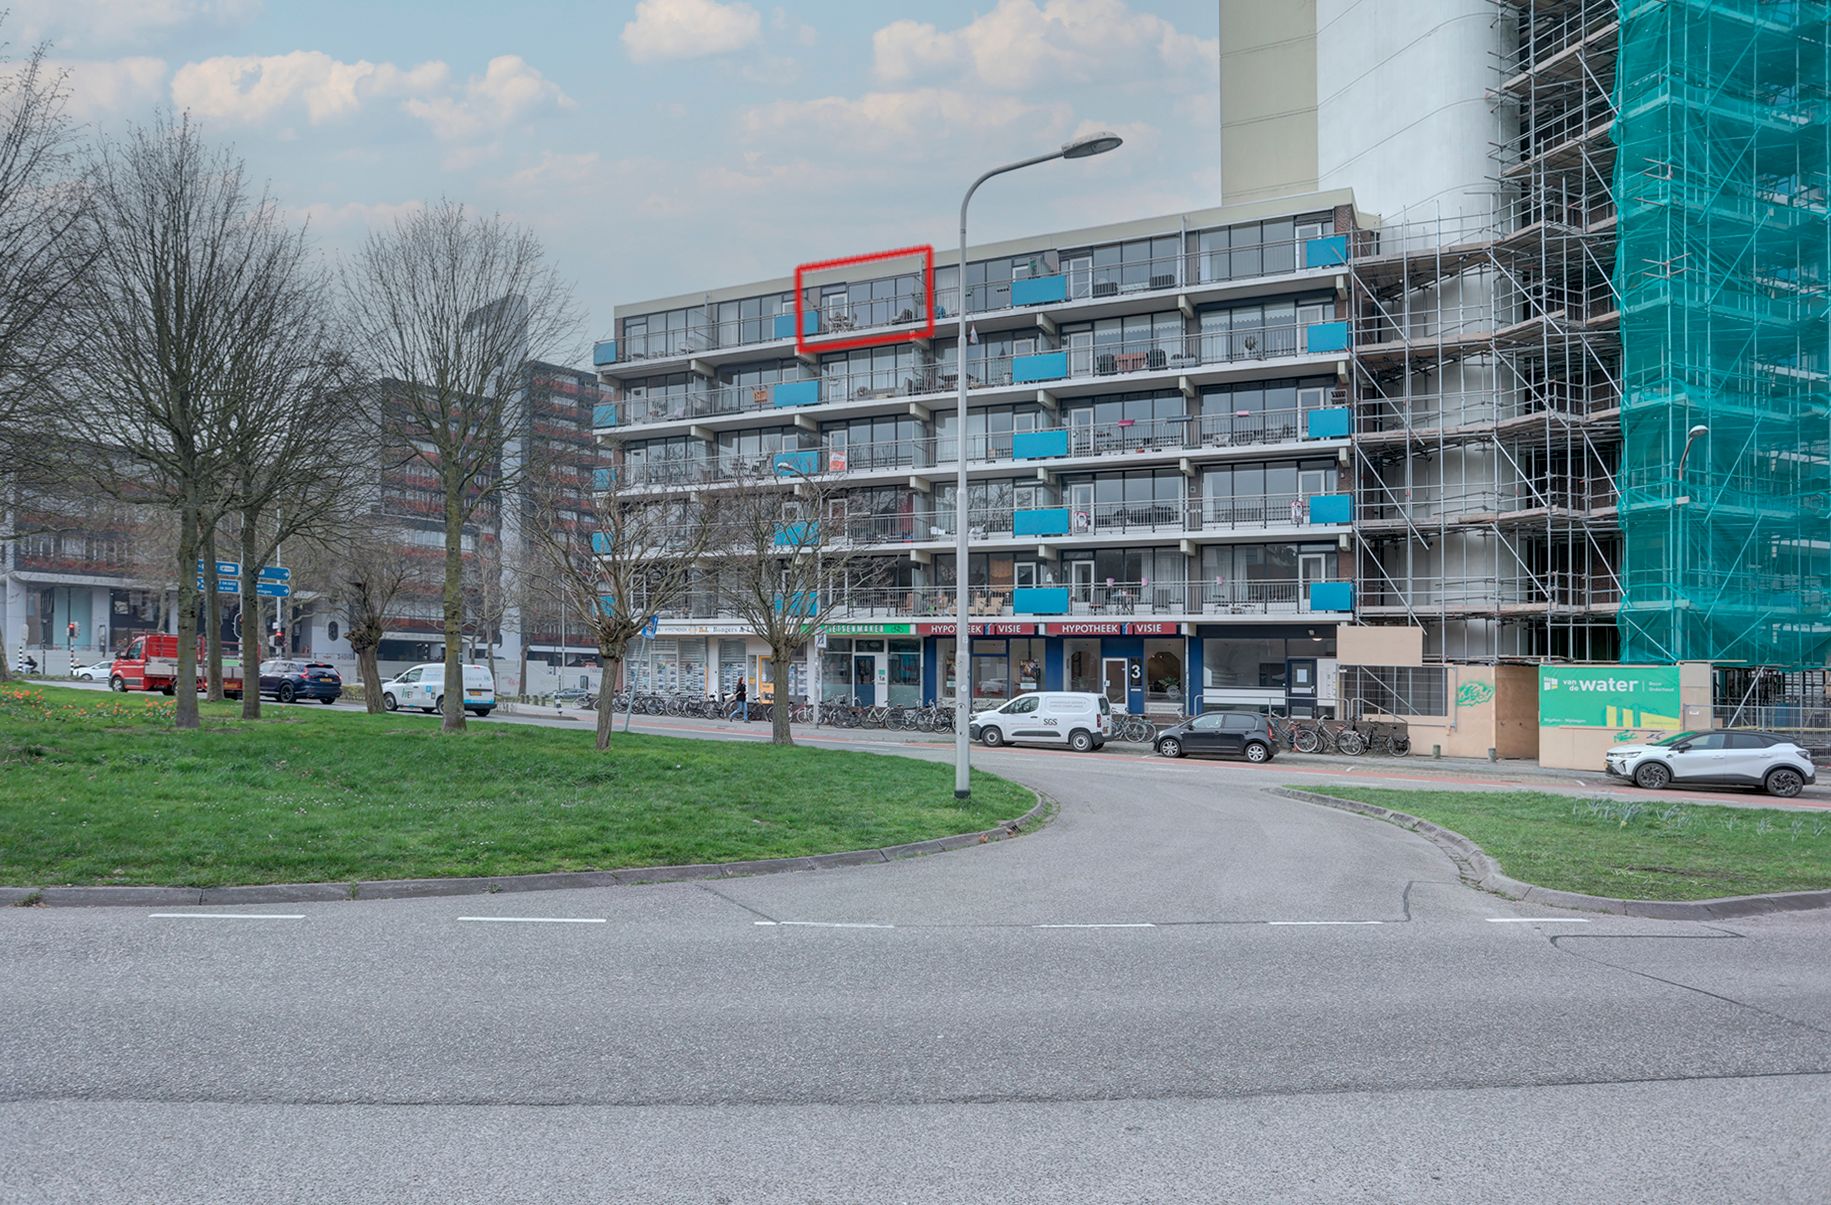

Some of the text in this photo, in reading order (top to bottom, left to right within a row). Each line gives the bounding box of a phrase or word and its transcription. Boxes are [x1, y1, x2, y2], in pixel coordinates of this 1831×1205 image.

[824, 623, 884, 633] IETSENMAKER
[931, 624, 1021, 633] HYPOEEK VISIE
[1062, 623, 1162, 633] HYPOTHEEK VISIE
[1131, 664, 1141, 679] 3
[1579, 677, 1639, 692] water
[1043, 718, 1058, 726] SGS
